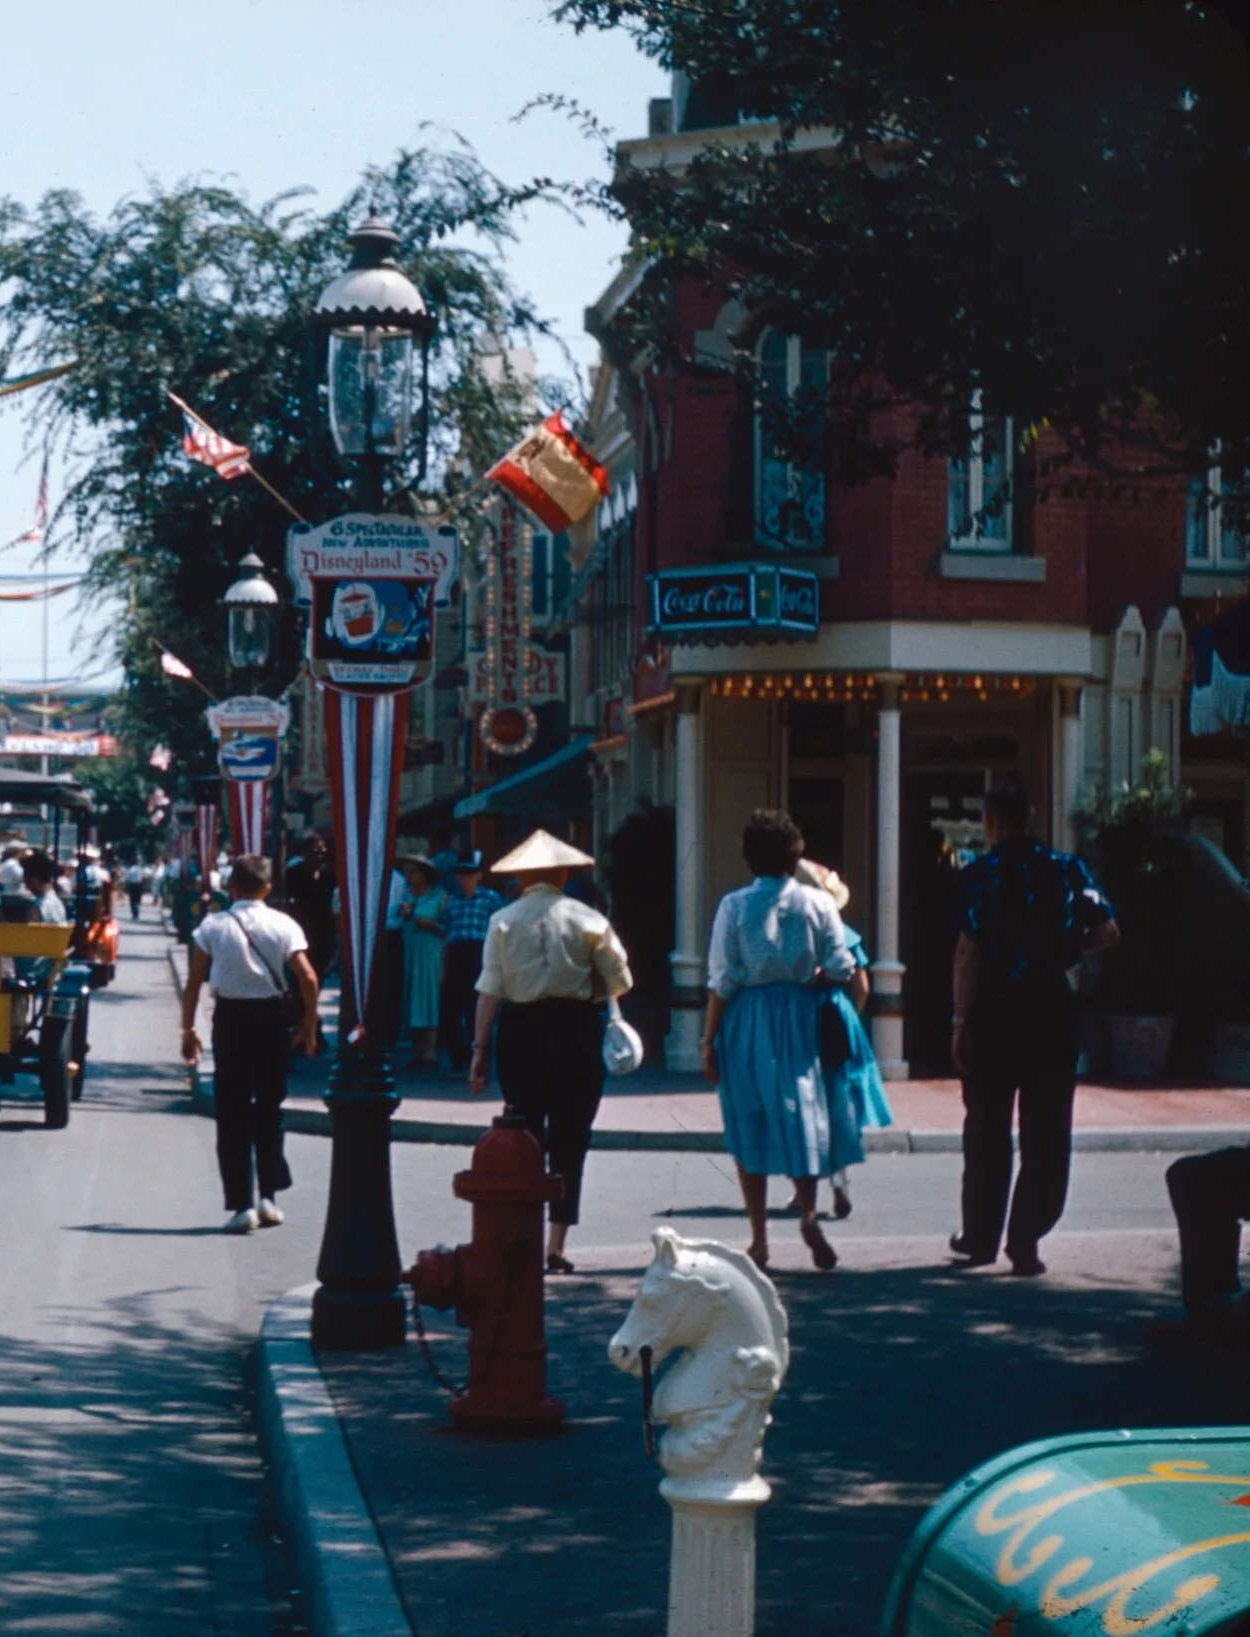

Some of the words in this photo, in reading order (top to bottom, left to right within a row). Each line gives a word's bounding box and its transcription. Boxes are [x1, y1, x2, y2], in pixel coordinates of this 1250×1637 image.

[330, 522, 343, 535] 6
[346, 522, 423, 536] SPECTACULAR
[353, 536, 430, 548] ADVENTURES
[301, 549, 402, 575] Disneyland
[408, 551, 447, 575] '59
[500, 507, 519, 703] REFRESHMENTS
